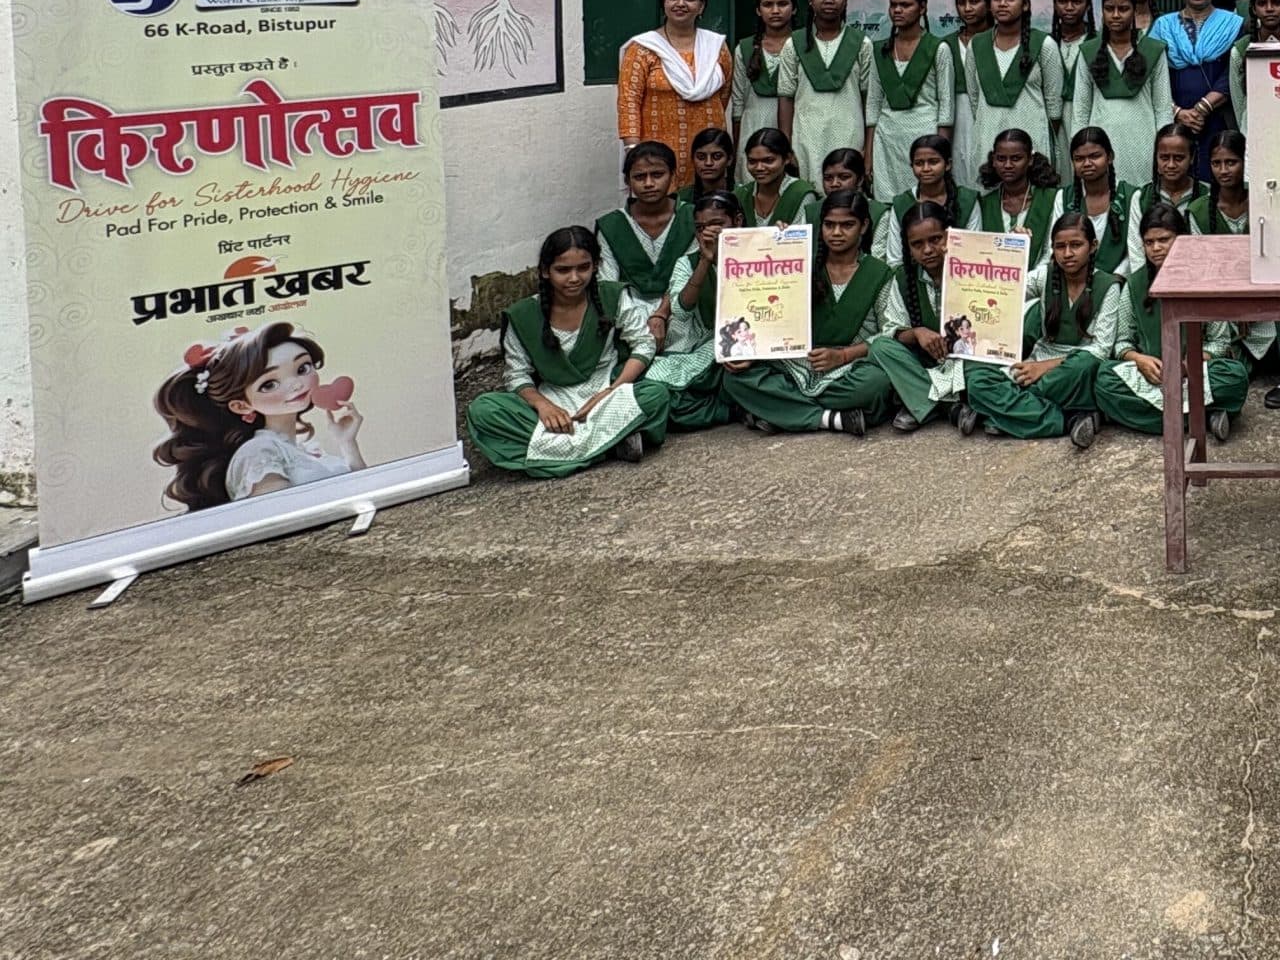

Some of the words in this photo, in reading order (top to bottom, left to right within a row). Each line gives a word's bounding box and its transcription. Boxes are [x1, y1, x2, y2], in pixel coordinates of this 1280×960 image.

[144, 23, 170, 38] 66
[175, 20, 252, 38] K-Road,
[258, 18, 337, 37] Bistupur
[190, 61, 236, 78] प्रस्तुत
[238, 58, 276, 73] करते
[39, 78, 425, 193] किरणोत्सव
[56, 196, 139, 225] Drive
[145, 193, 183, 217] for
[194, 171, 323, 209] Sisterhood
[330, 167, 421, 196] Hygiene
[105, 219, 142, 238] Pad
[147, 217, 176, 233] For
[183, 210, 234, 229] Pride,
[239, 199, 319, 221] Protection
[324, 196, 338, 208] &
[341, 190, 385, 207] Smile
[218, 238, 246, 256] प्रिंट
[246, 233, 291, 253] पार्टनर
[724, 254, 805, 280] किरणोत्सव
[949, 257, 1022, 283] किरणोत्सव
[131, 275, 256, 326] प्रभात
[263, 259, 372, 300] खबर
